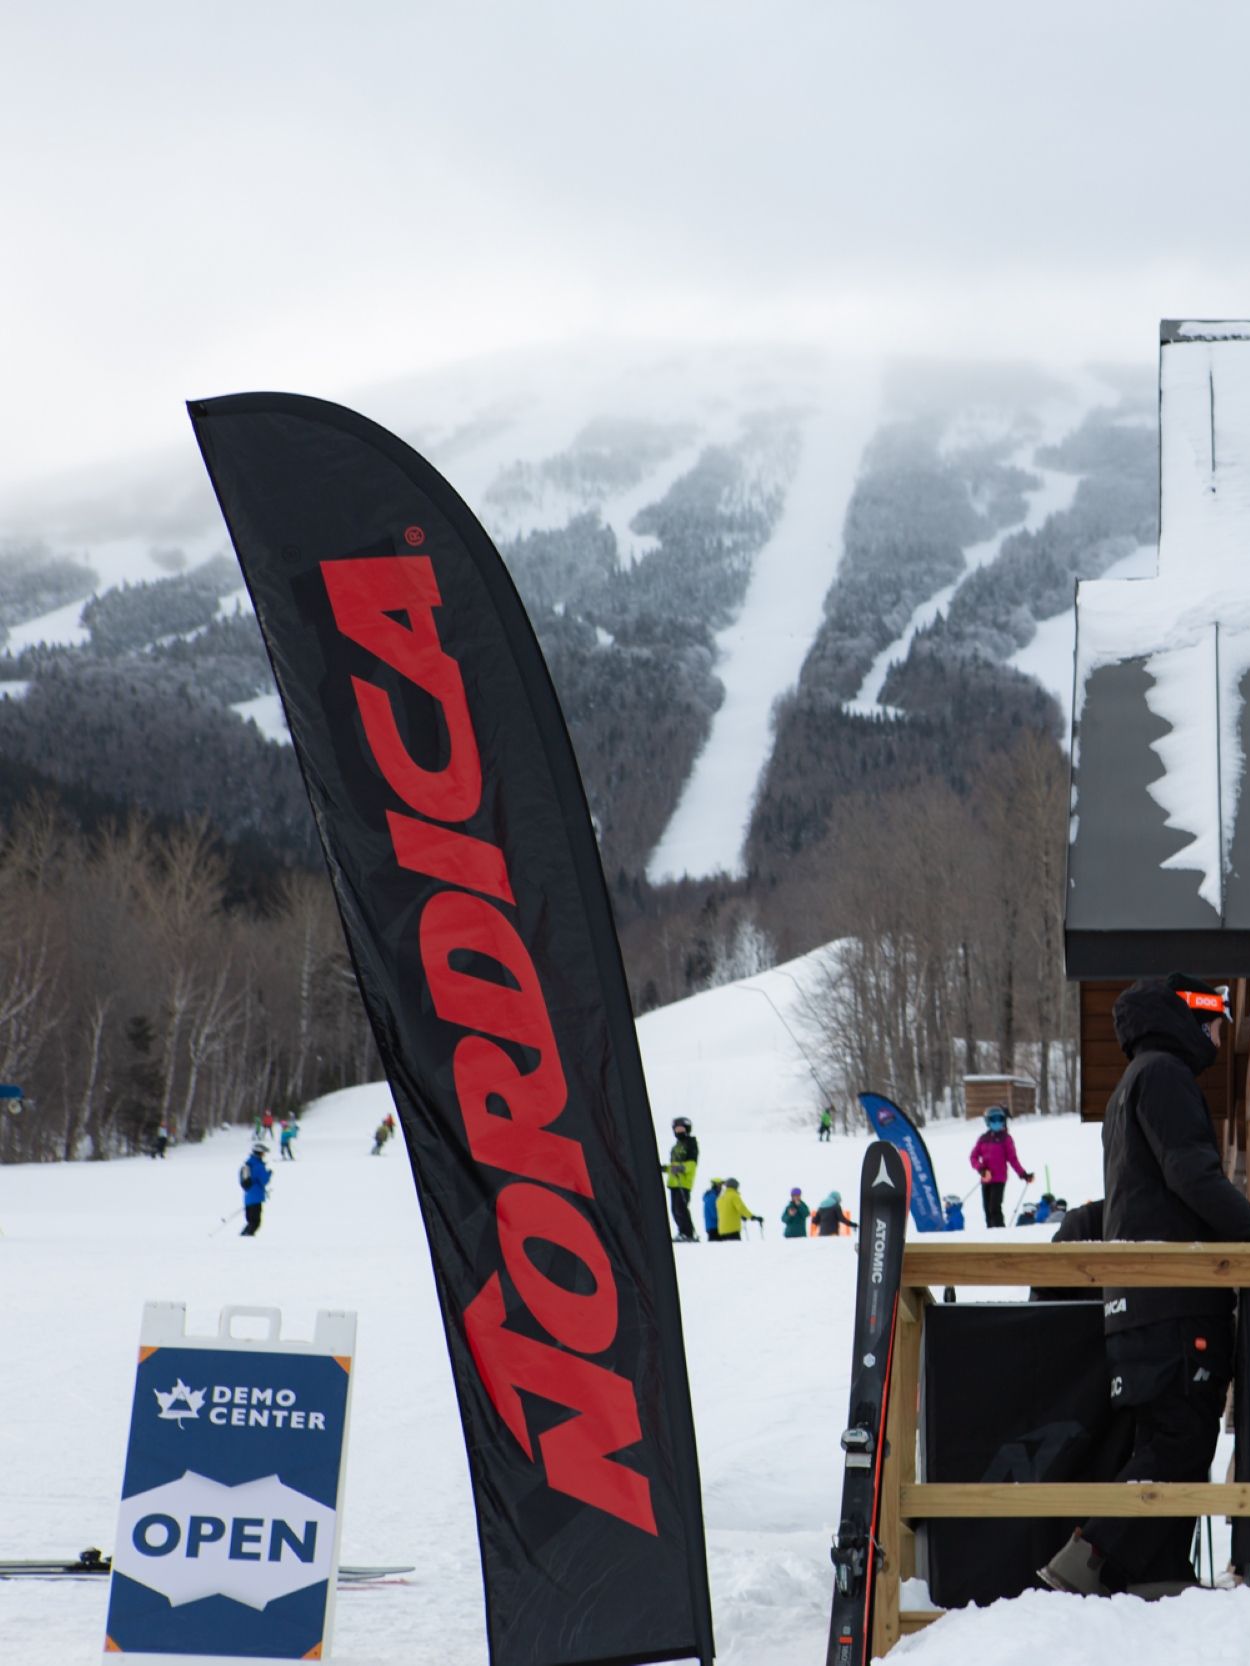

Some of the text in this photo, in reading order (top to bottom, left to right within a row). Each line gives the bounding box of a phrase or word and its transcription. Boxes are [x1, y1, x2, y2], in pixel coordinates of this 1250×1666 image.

[320, 555, 658, 1535] NORDICA
[871, 1218, 887, 1284] ATOMIC
[209, 1407, 326, 1430] CENTER
[212, 1385, 296, 1407] DEMO
[132, 1513, 318, 1563] OPEN
